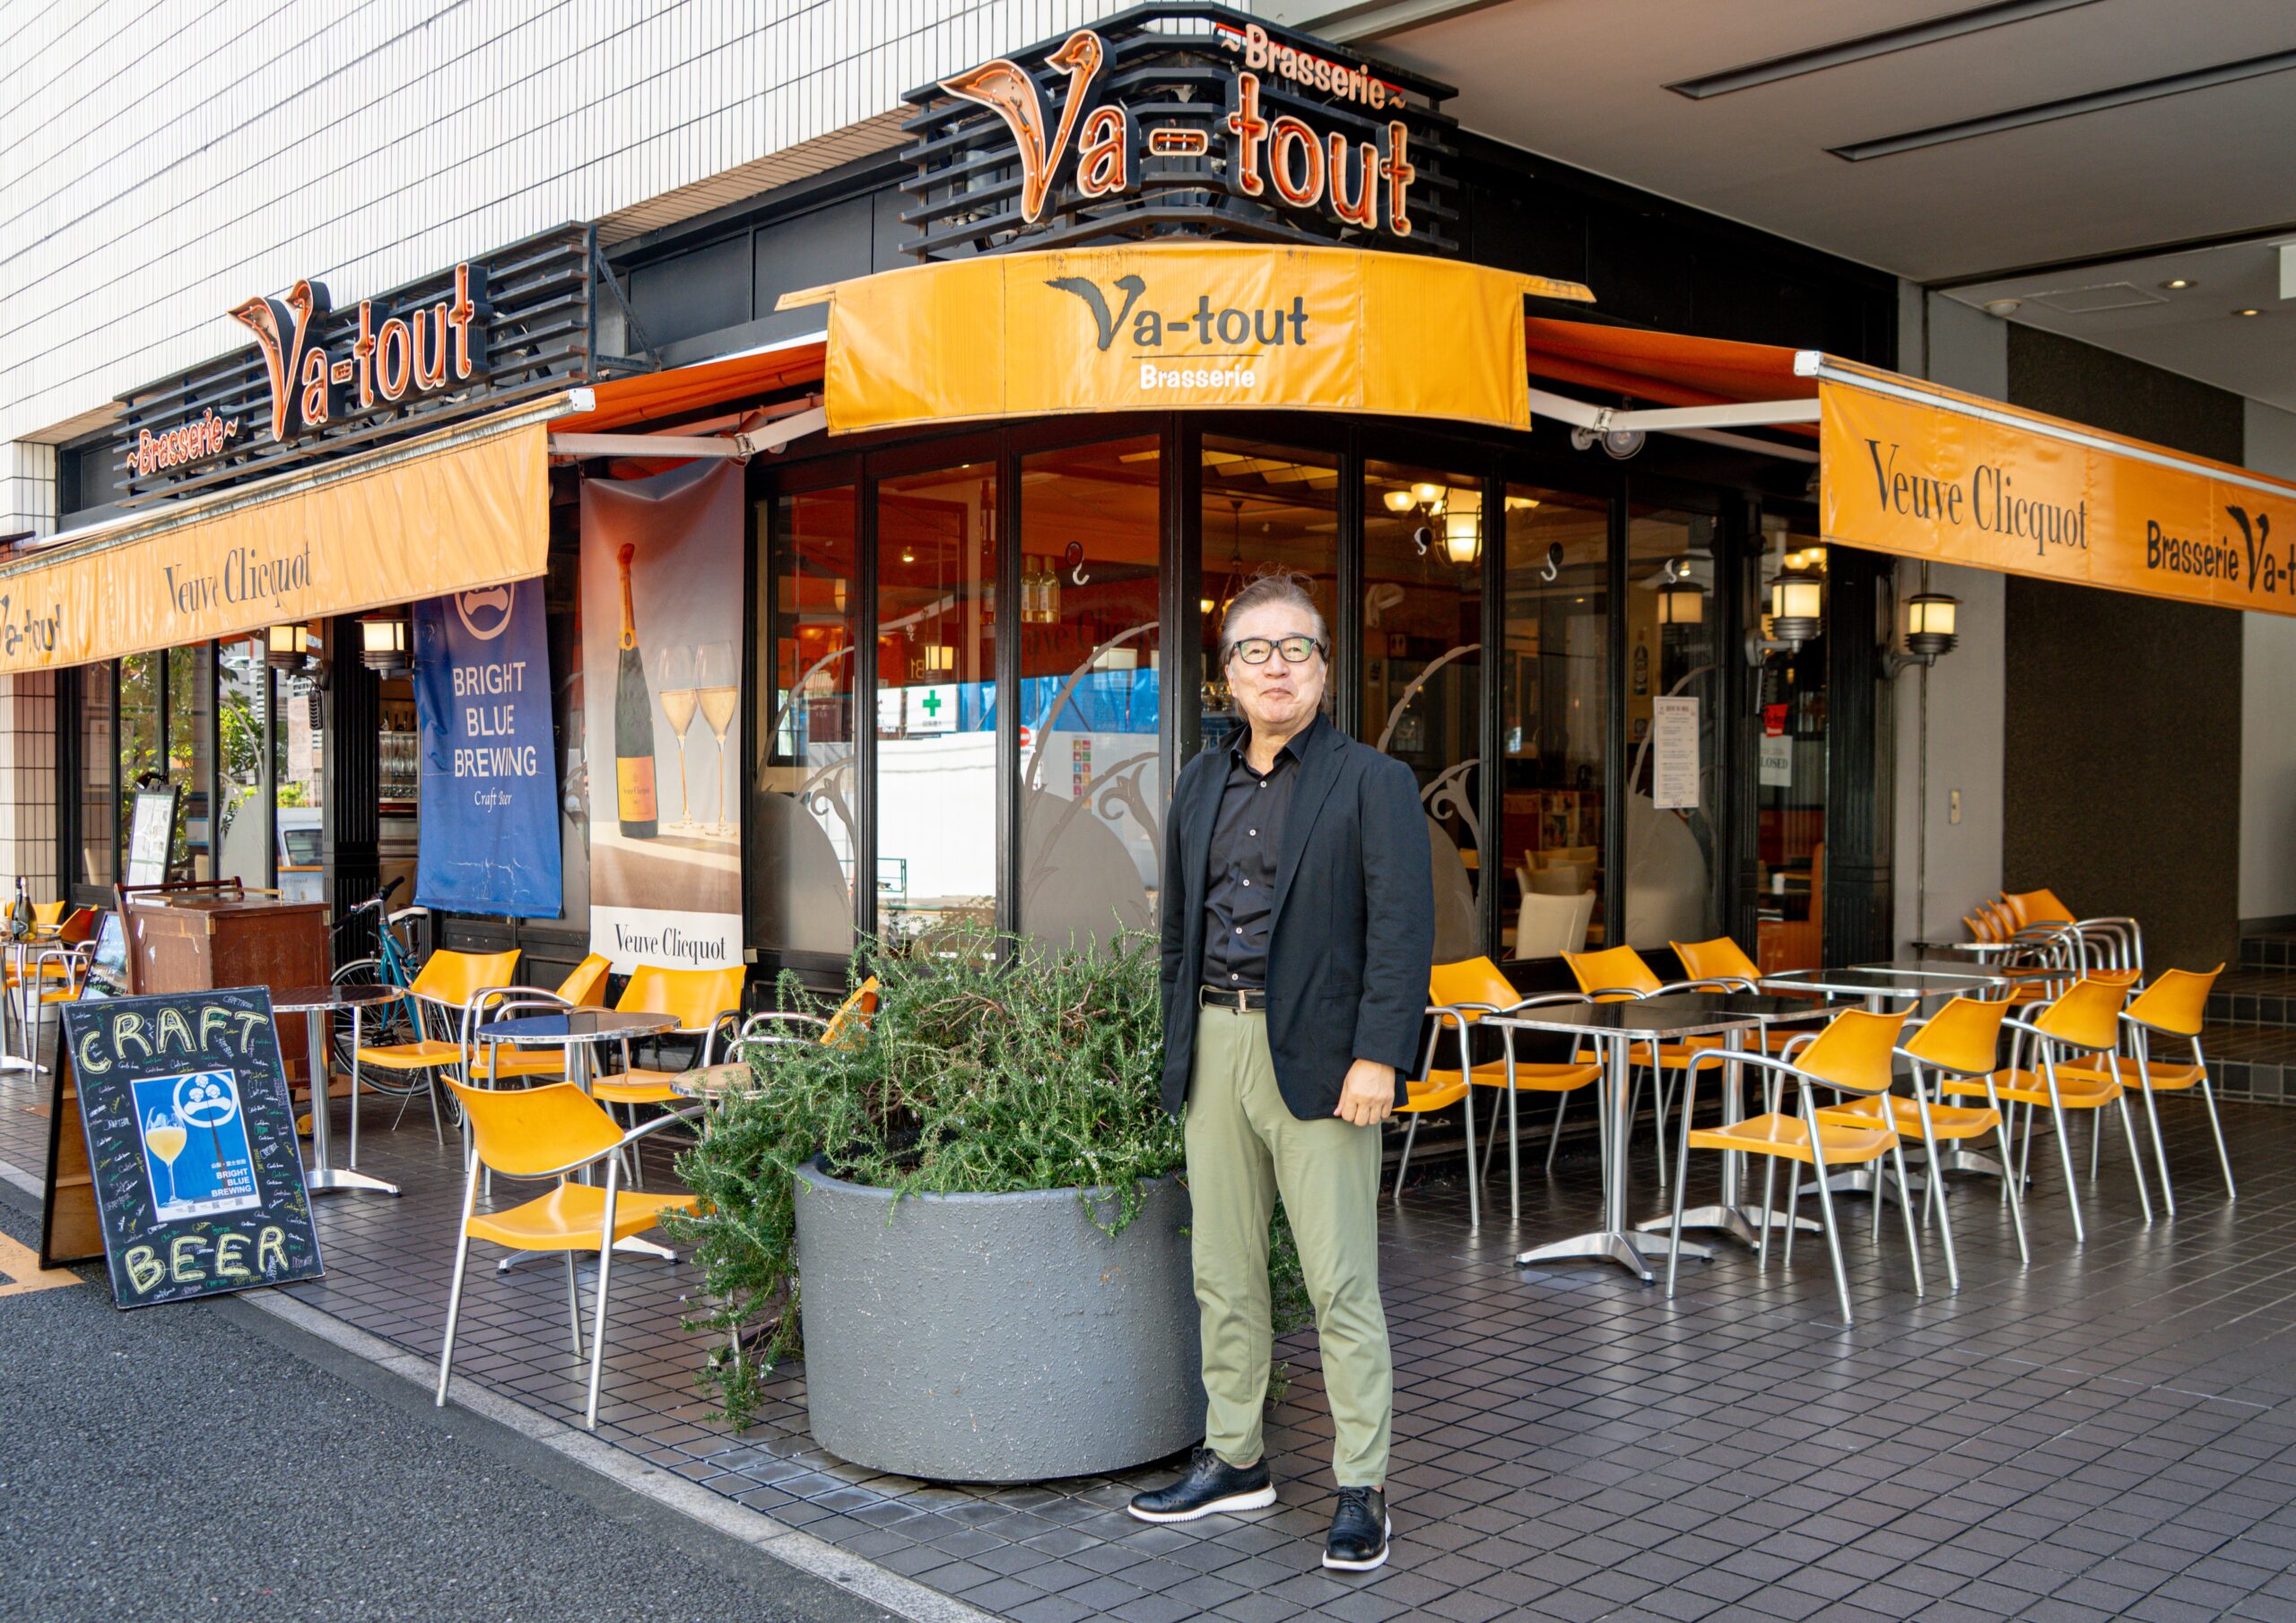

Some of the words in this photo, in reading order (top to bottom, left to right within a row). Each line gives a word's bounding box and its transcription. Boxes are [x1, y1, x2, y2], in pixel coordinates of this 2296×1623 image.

[937, 30, 1415, 237] Va-tout
[1043, 274, 1309, 352] Va-tout
[228, 262, 474, 442] Va-tout
[1140, 364, 1256, 389] Brasserie
[1864, 438, 1963, 525] Veuve
[1973, 464, 2089, 556] Clicquot
[2147, 519, 2239, 582] Brasserie
[163, 563, 218, 615] Veuve
[224, 541, 310, 608] Clicquot
[453, 662, 526, 697] BRIGHT
[466, 705, 515, 736] BLUE
[455, 746, 536, 777] BREWING
[1760, 757, 1787, 769] LOSED
[474, 787, 496, 813] Craft
[614, 924, 658, 954] Veuve
[663, 927, 726, 965] Clicquot
[80, 1006, 269, 1074] CRAFT
[211, 1185, 252, 1197] BREWING
[216, 1168, 248, 1179] BRIGHT
[227, 1176, 250, 1186] BLUE
[125, 1226, 290, 1294] BEER
